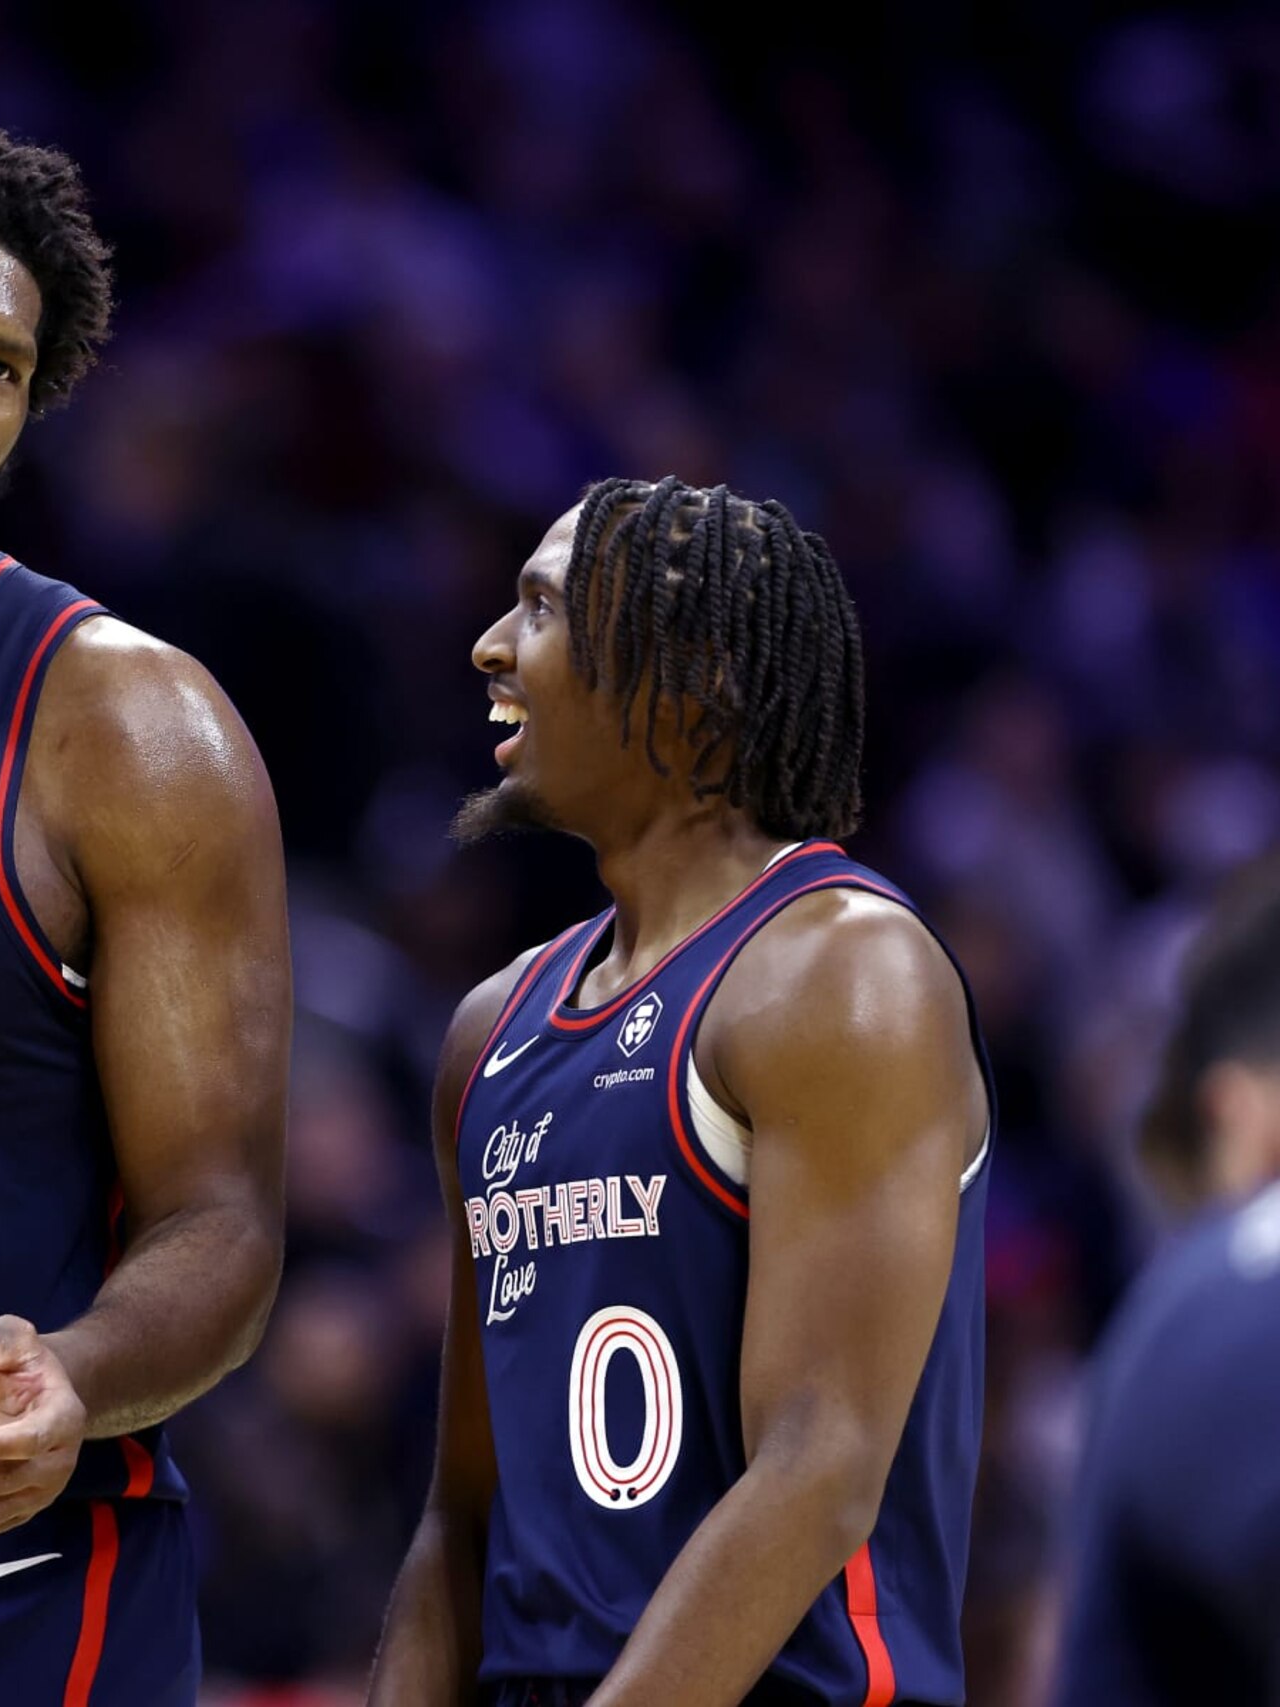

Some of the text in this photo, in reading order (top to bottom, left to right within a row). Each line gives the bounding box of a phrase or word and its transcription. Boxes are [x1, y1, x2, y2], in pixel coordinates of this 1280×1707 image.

[593, 1067, 655, 1089] crypto.com
[482, 1111, 553, 1199] City of
[465, 1175, 666, 1258] ROTHERLY
[486, 1254, 536, 1326] Love
[569, 1306, 683, 1510] 0
